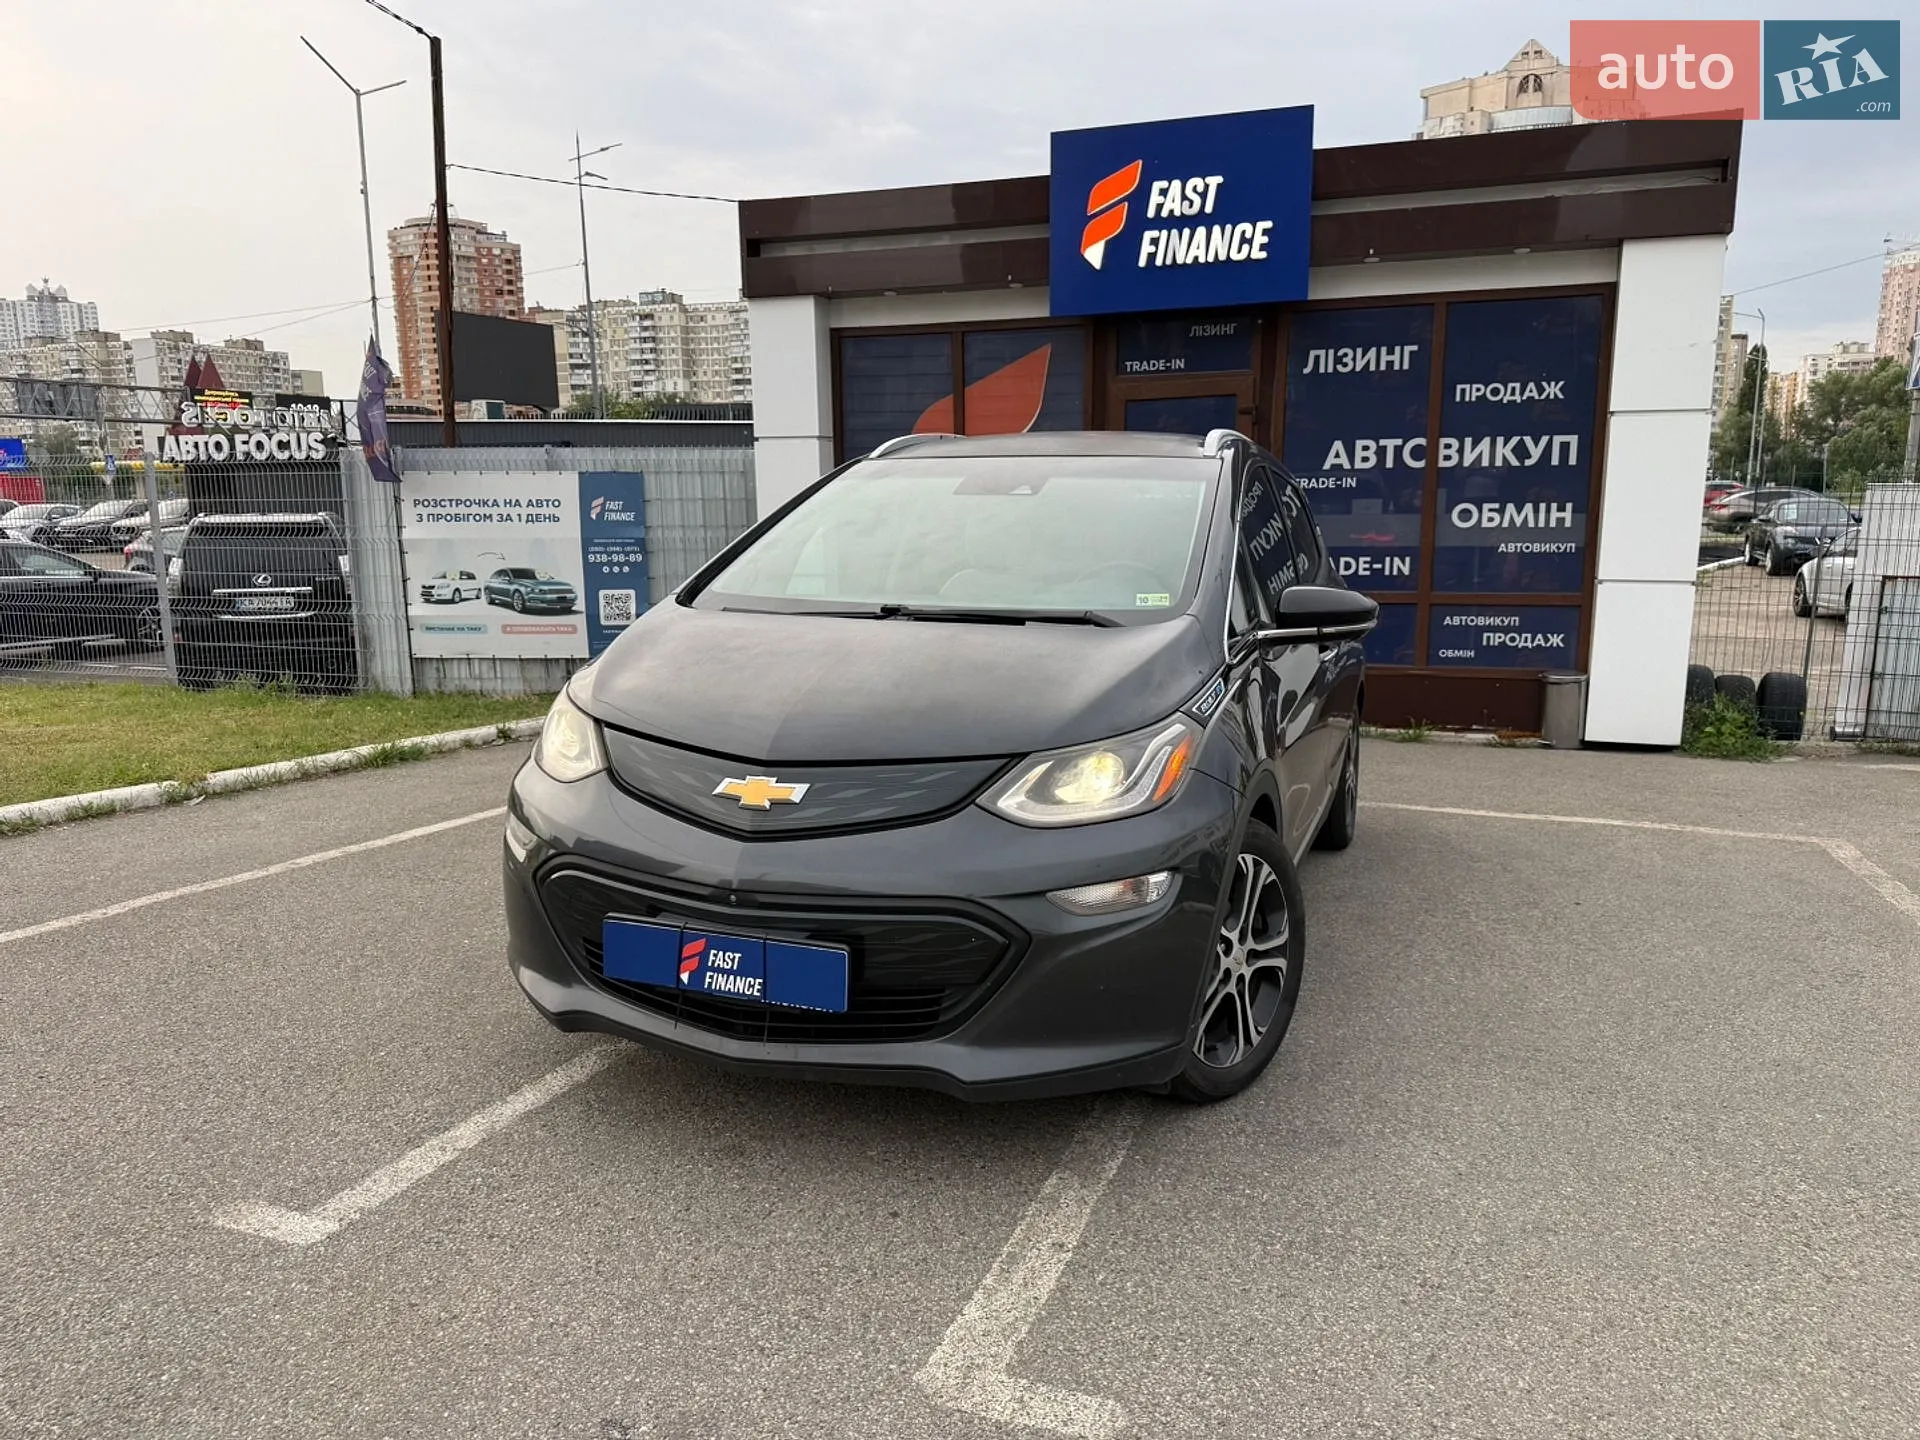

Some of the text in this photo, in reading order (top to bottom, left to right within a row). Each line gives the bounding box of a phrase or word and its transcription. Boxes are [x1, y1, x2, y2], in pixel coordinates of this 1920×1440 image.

[1146, 175, 1224, 219] FAST
[1137, 220, 1273, 268] FINANCE
[1189, 323, 1237, 337] ЛІЗИНГ
[1125, 358, 1185, 373] TRADE-IN
[1302, 345, 1418, 374] ЛІЗИНГ
[1455, 380, 1565, 403] ПРОДАЖ
[163, 432, 327, 461] АВТО FOCUS
[413, 498, 561, 508] РОЗСТРОЧКА НА АВТО
[605, 501, 624, 510] FAST
[427, 513, 493, 522] ПРОБІГОМ
[496, 513, 513, 522] ЗА
[516, 513, 522, 522] 1
[525, 513, 560, 524] ДЕНЬ
[603, 511, 636, 522] FINANCE
[1451, 502, 1573, 529] ОБМІН
[1497, 542, 1576, 554] АВТОВИКУП
[588, 553, 643, 563] 938-98-89
[1443, 616, 1520, 628] АВТОВИКУП
[1482, 632, 1565, 649] ПРОДАЖ
[1439, 650, 1475, 659] ОБМІН
[708, 949, 742, 970] FAST
[704, 971, 763, 996] FINANCE
